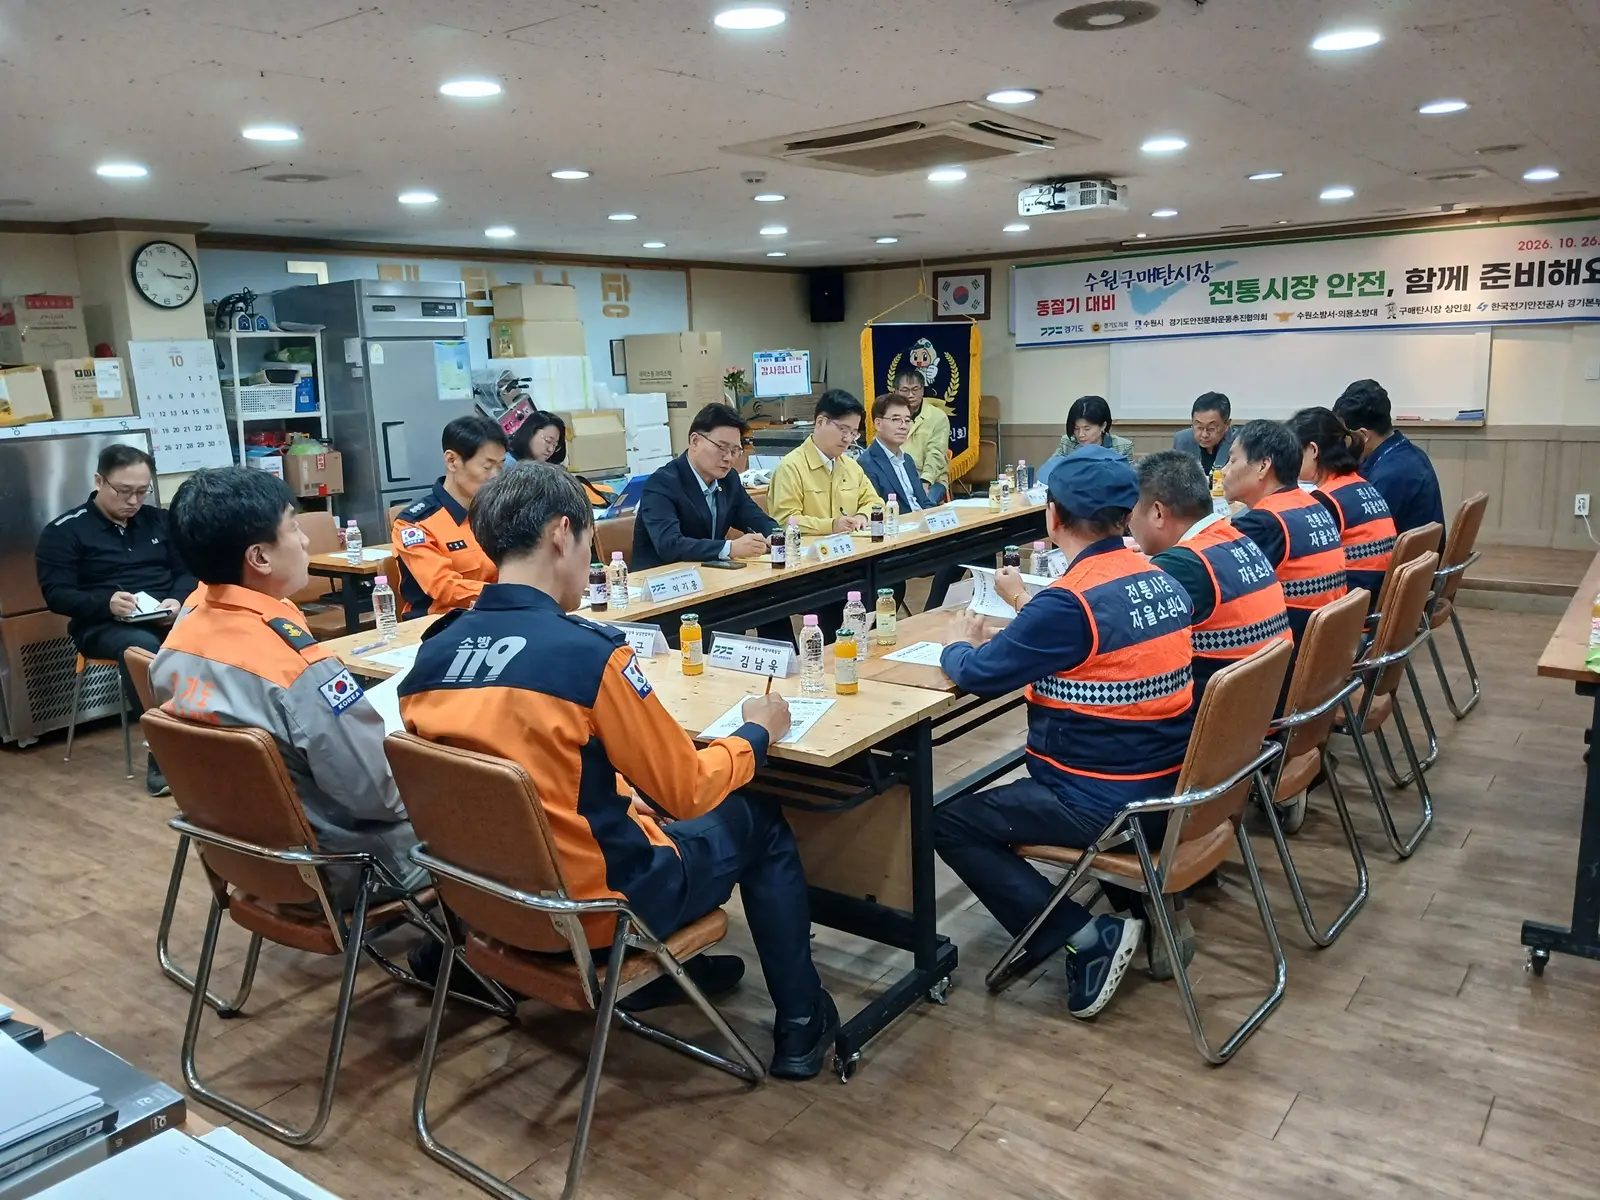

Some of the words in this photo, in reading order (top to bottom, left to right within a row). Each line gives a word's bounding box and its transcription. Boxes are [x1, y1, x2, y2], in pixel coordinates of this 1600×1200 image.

[1518, 239, 1552, 251] 2026.
[1559, 237, 1576, 248] 10.
[1085, 261, 1213, 291] 수원구매탄시장
[1209, 275, 1319, 305] 전통시장
[1327, 270, 1394, 299] 안전,
[1405, 265, 1469, 295] 함께
[1037, 297, 1080, 317] 동절기
[1085, 294, 1116, 312] 대비
[1399, 304, 1442, 315] 구매탄시장
[1445, 303, 1471, 313] 상인회
[1491, 300, 1564, 311] 한국전기안전공사
[1064, 325, 1084, 334] 경기도
[1143, 319, 1164, 328] 수원시
[169, 355, 184, 367] 10
[761, 365, 801, 376] 감사합니다
[1124, 576, 1173, 604] 전통시장
[1129, 595, 1188, 630] 자율소방대
[458, 636, 492, 649] 소방
[441, 635, 527, 682] 119
[337, 691, 360, 710] KOREA
